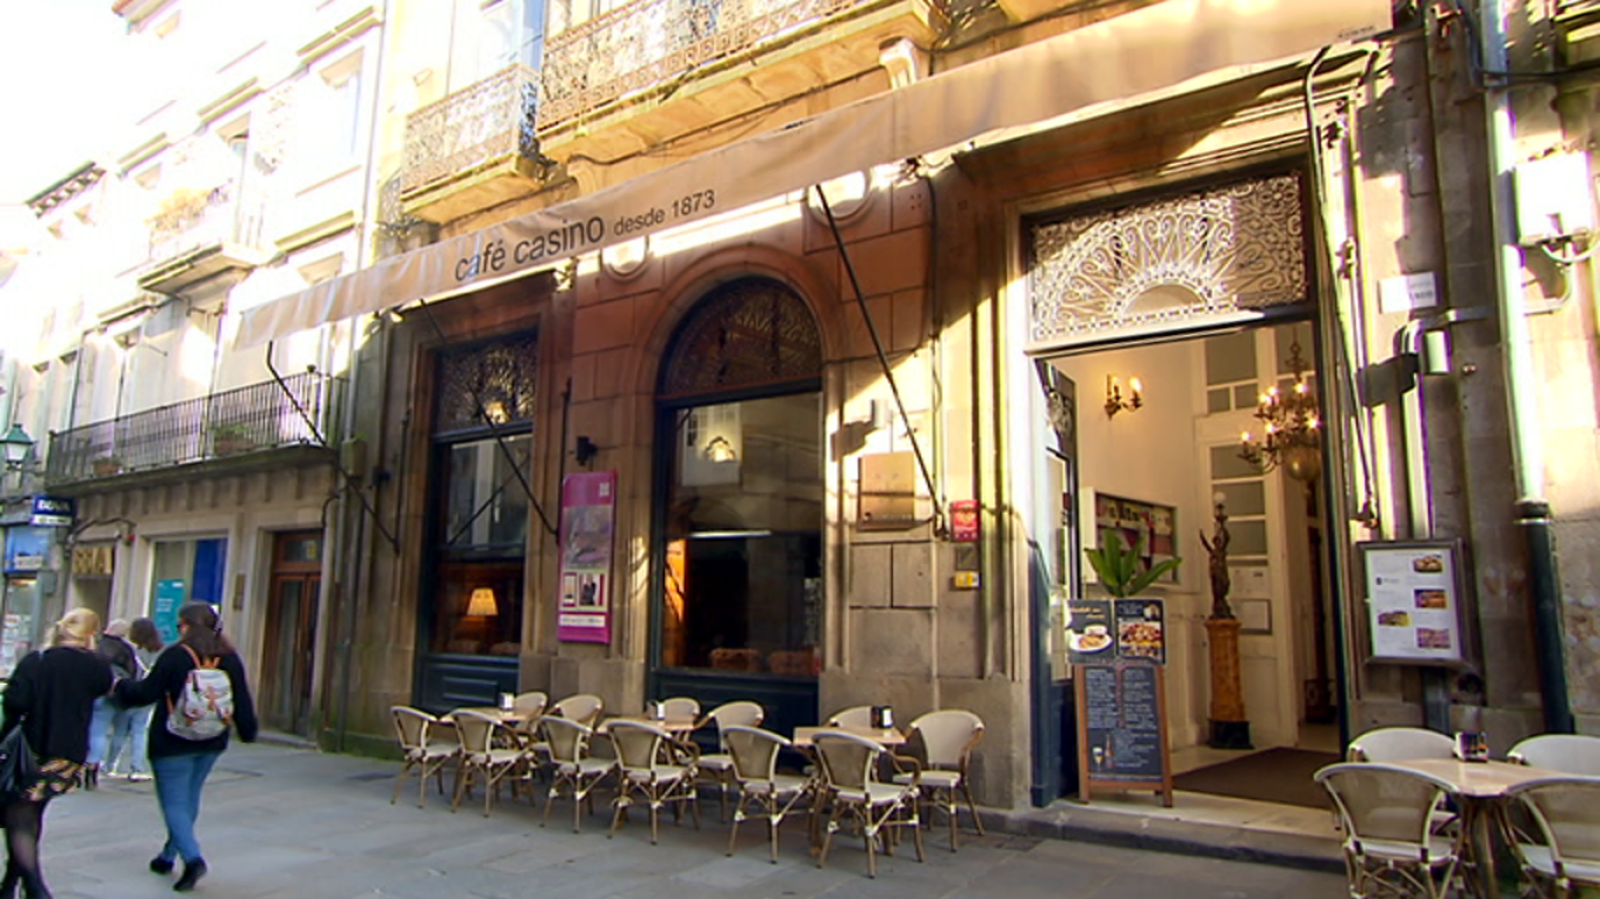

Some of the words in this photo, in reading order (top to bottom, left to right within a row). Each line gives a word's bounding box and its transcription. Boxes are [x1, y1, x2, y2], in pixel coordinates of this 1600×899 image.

[455, 239, 506, 281] café
[513, 215, 605, 264] casino
[613, 207, 666, 236] desde
[671, 189, 715, 218] 1873
